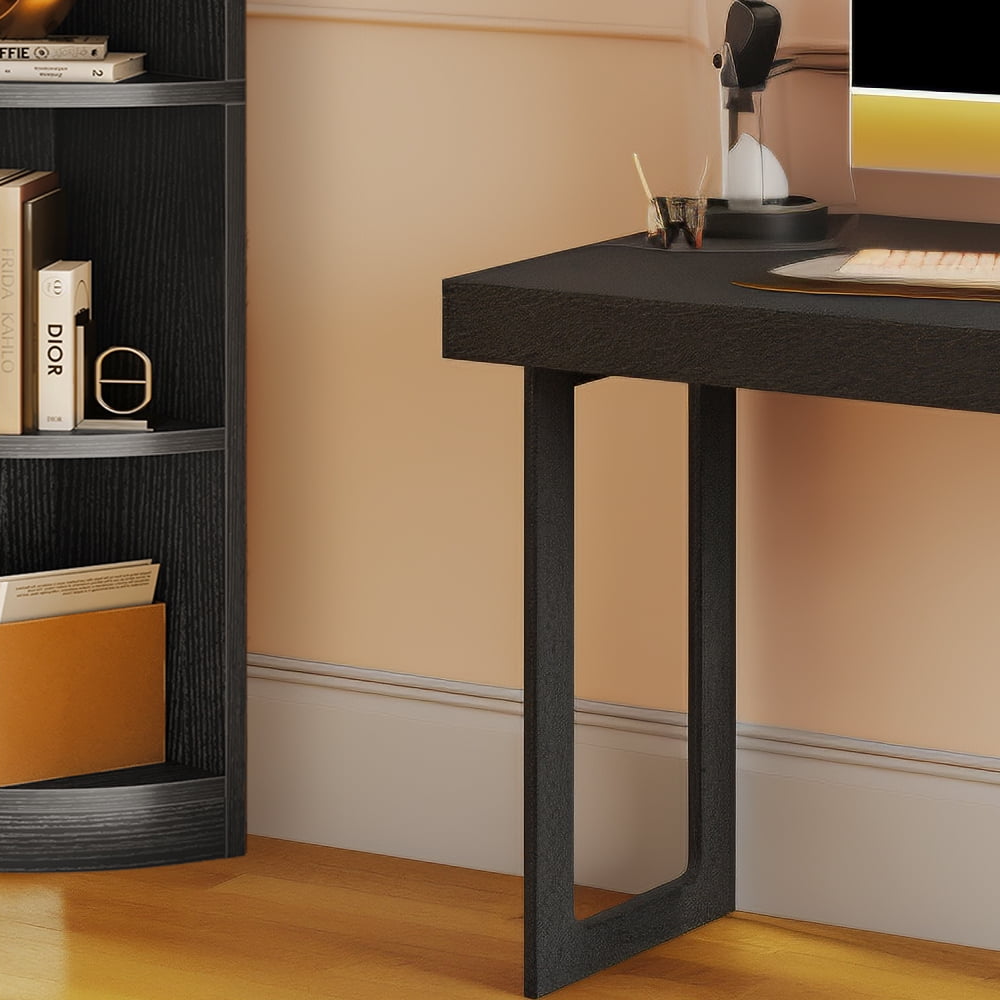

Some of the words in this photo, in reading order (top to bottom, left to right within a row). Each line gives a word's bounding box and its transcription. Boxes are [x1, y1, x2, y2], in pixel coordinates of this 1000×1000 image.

[92, 69, 104, 77] 2
[1, 248, 15, 300] FRIDA
[1, 312, 15, 374] KAHLO
[47, 324, 63, 376] DIOR
